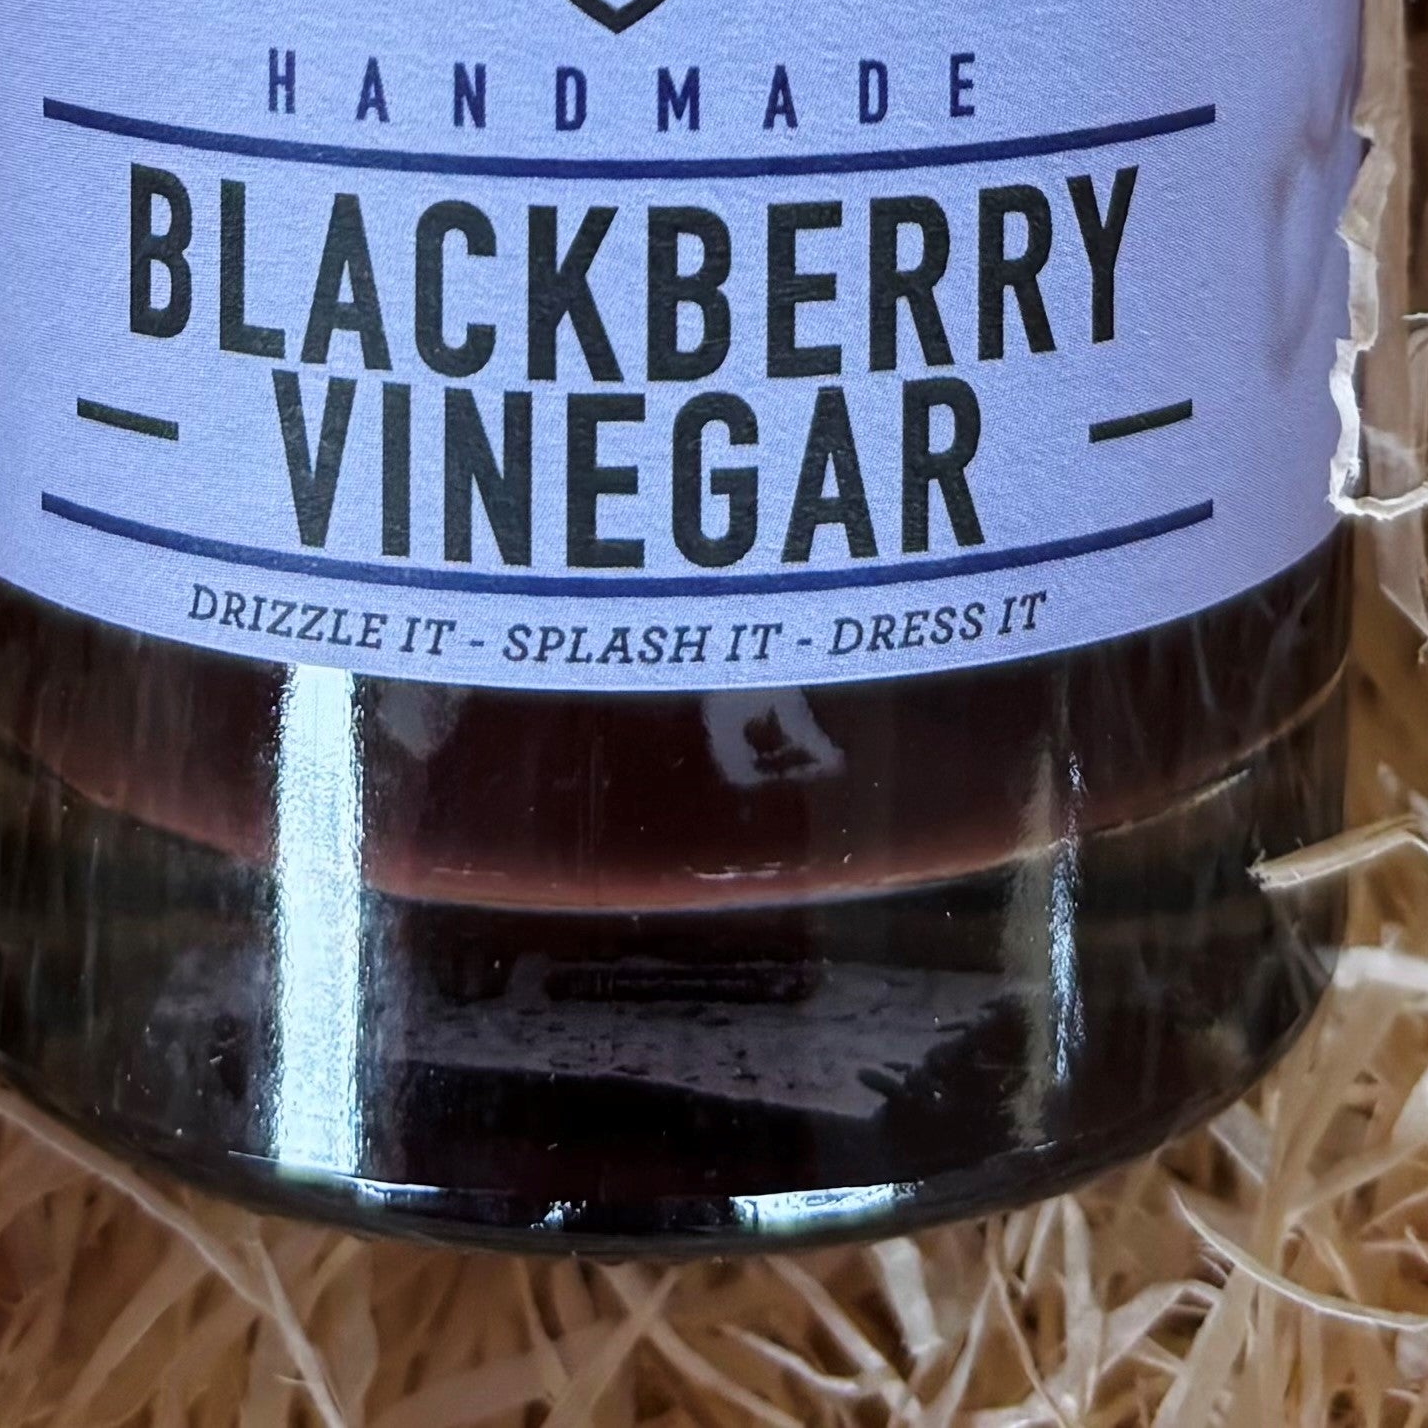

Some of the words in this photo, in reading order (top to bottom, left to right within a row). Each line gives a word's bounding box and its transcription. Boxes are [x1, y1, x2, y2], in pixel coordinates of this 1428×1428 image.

[269, 48, 975, 132] HANDMADE
[130, 162, 1139, 382] BLACKBERRY
[272, 369, 985, 568] VINEGAR
[189, 584, 387, 649] DRIZZLE
[400, 617, 456, 654] IT
[503, 624, 711, 662] SPLASH
[727, 623, 782, 660] IT
[828, 602, 984, 654] DRESS
[1000, 591, 1046, 633] IT
